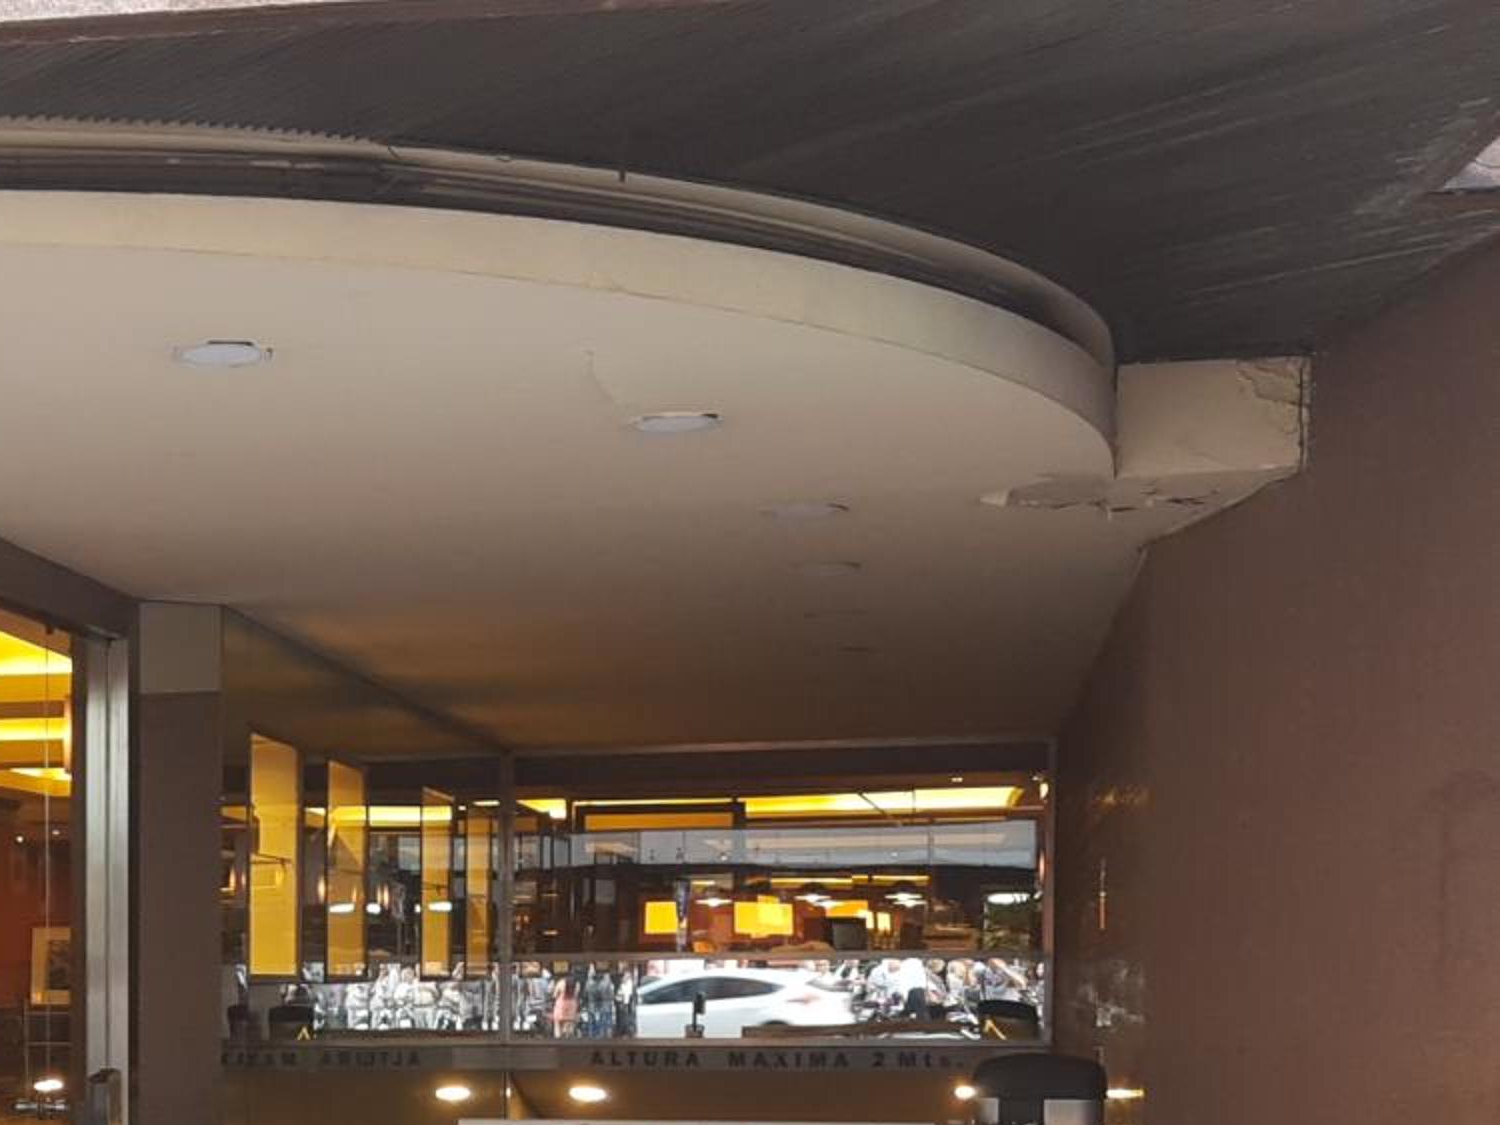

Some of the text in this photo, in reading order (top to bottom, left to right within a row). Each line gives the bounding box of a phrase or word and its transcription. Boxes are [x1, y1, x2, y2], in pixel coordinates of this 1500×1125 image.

[591, 1051, 700, 1068] ALTURA
[727, 1051, 849, 1068] MAXIMA
[871, 1051, 886, 1068] 2
